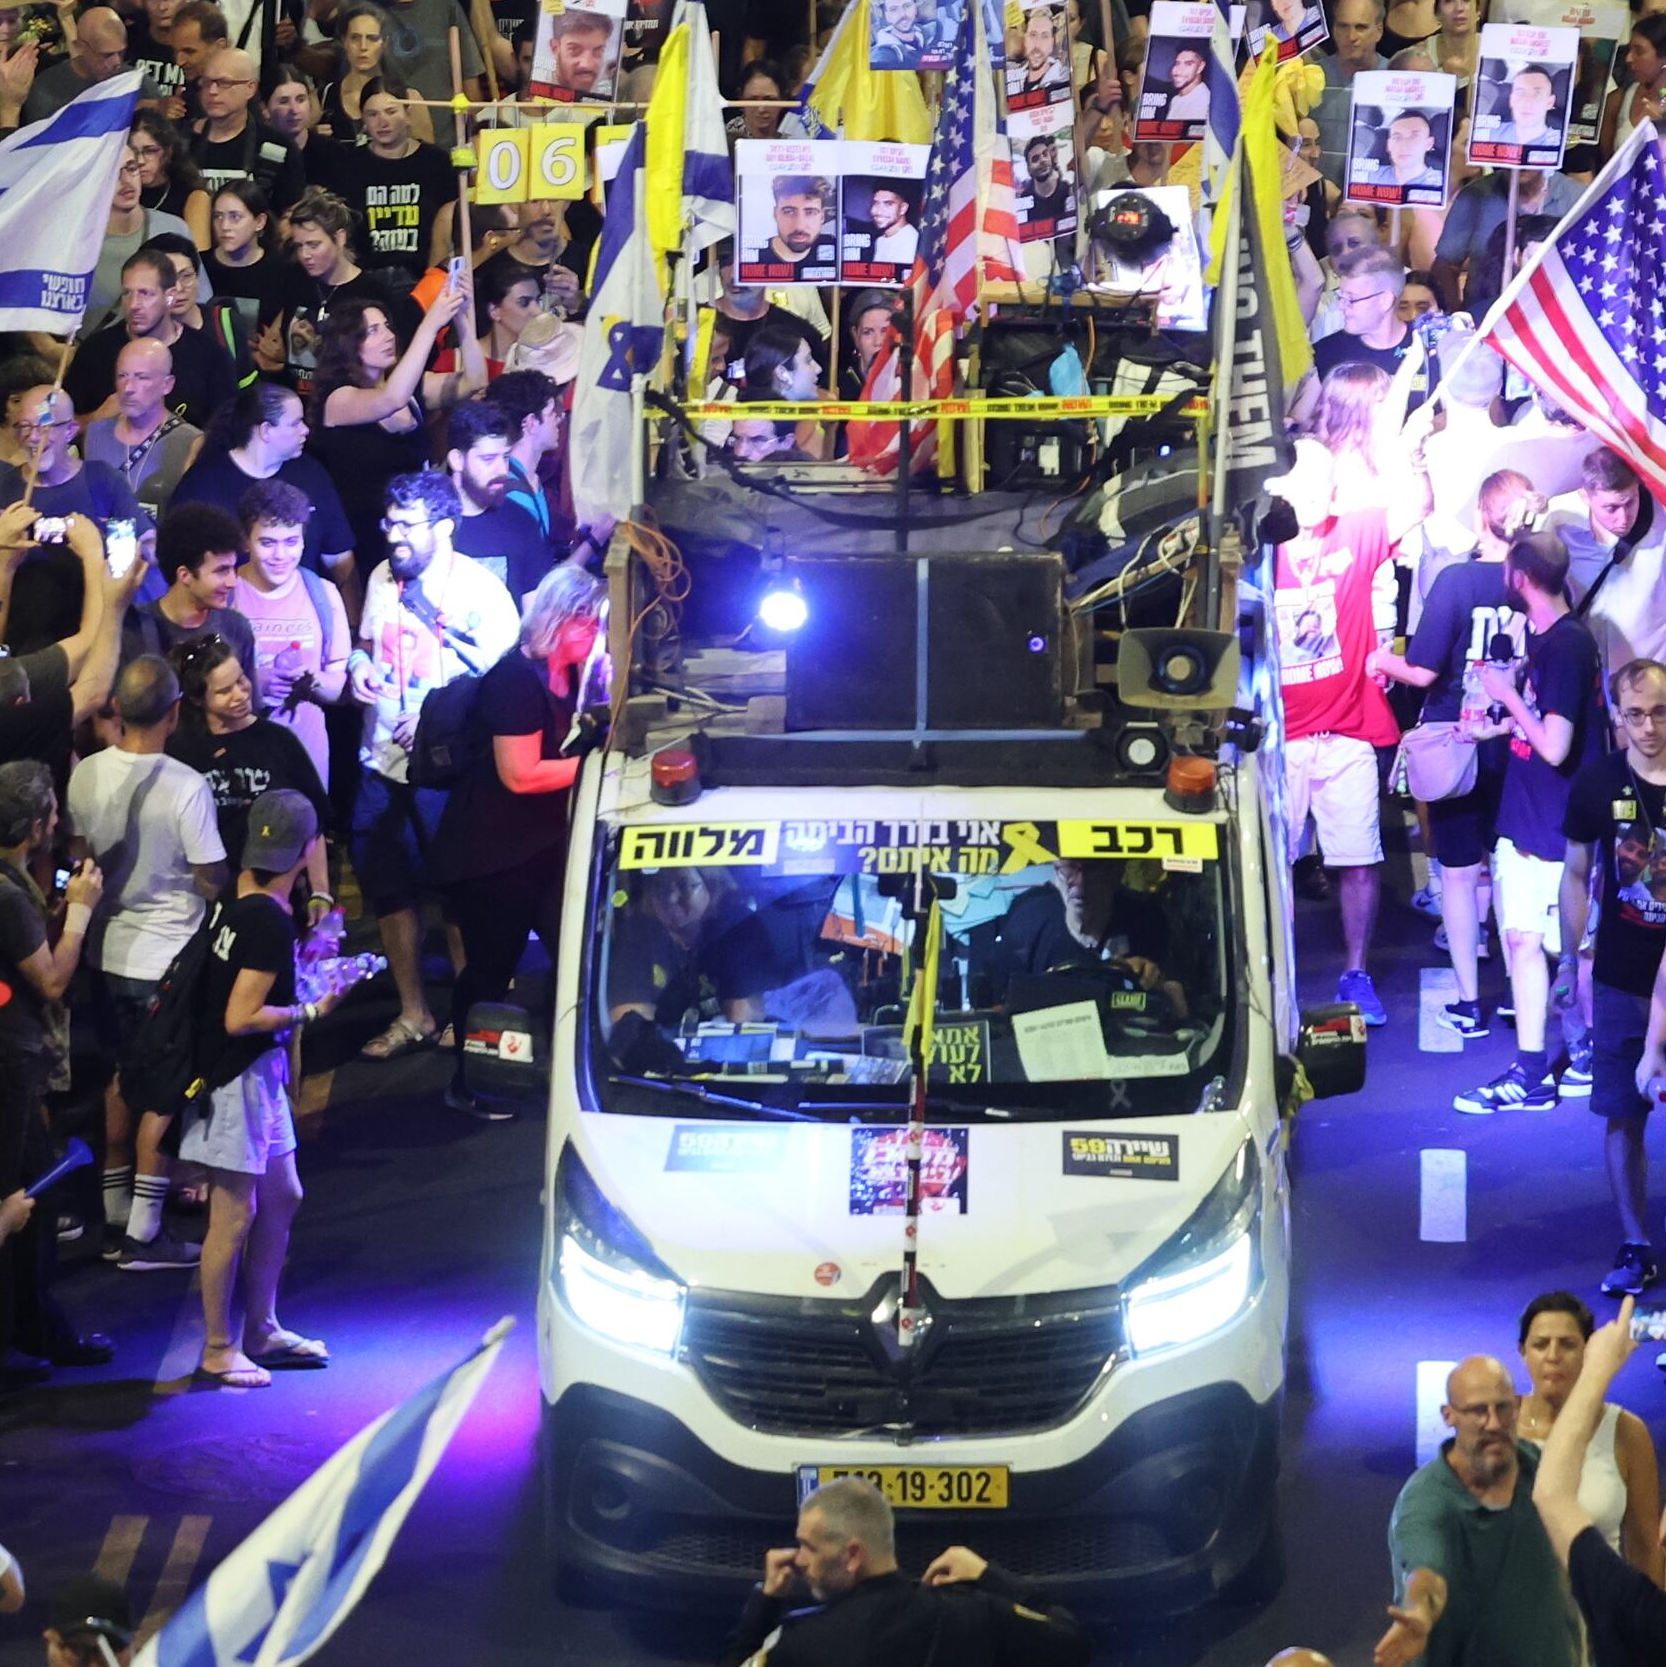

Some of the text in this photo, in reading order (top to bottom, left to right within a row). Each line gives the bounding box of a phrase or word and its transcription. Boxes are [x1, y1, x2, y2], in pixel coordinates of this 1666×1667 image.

[1143, 92, 1167, 107] BRING
[1141, 106, 1156, 119] HIM
[1476, 115, 1501, 128] BRING
[1352, 157, 1379, 171] BRING
[366, 183, 420, 206] למה הם
[1350, 182, 1402, 199] HOME NOW!
[367, 205, 420, 230] עדיין
[371, 227, 420, 252] בעזה?
[742, 234, 769, 249] BRING
[843, 234, 870, 248] BRING
[42, 273, 85, 294] חופשי
[40, 289, 85, 312] בארצנו
[1227, 330, 1278, 468] THEM
[1282, 664, 1314, 686] HOME
[962, 820, 1001, 843] אני
[1093, 825, 1184, 855] רכב
[634, 827, 764, 861] מלווה
[959, 846, 1000, 874] מה
[949, 1063, 983, 1084] לא
